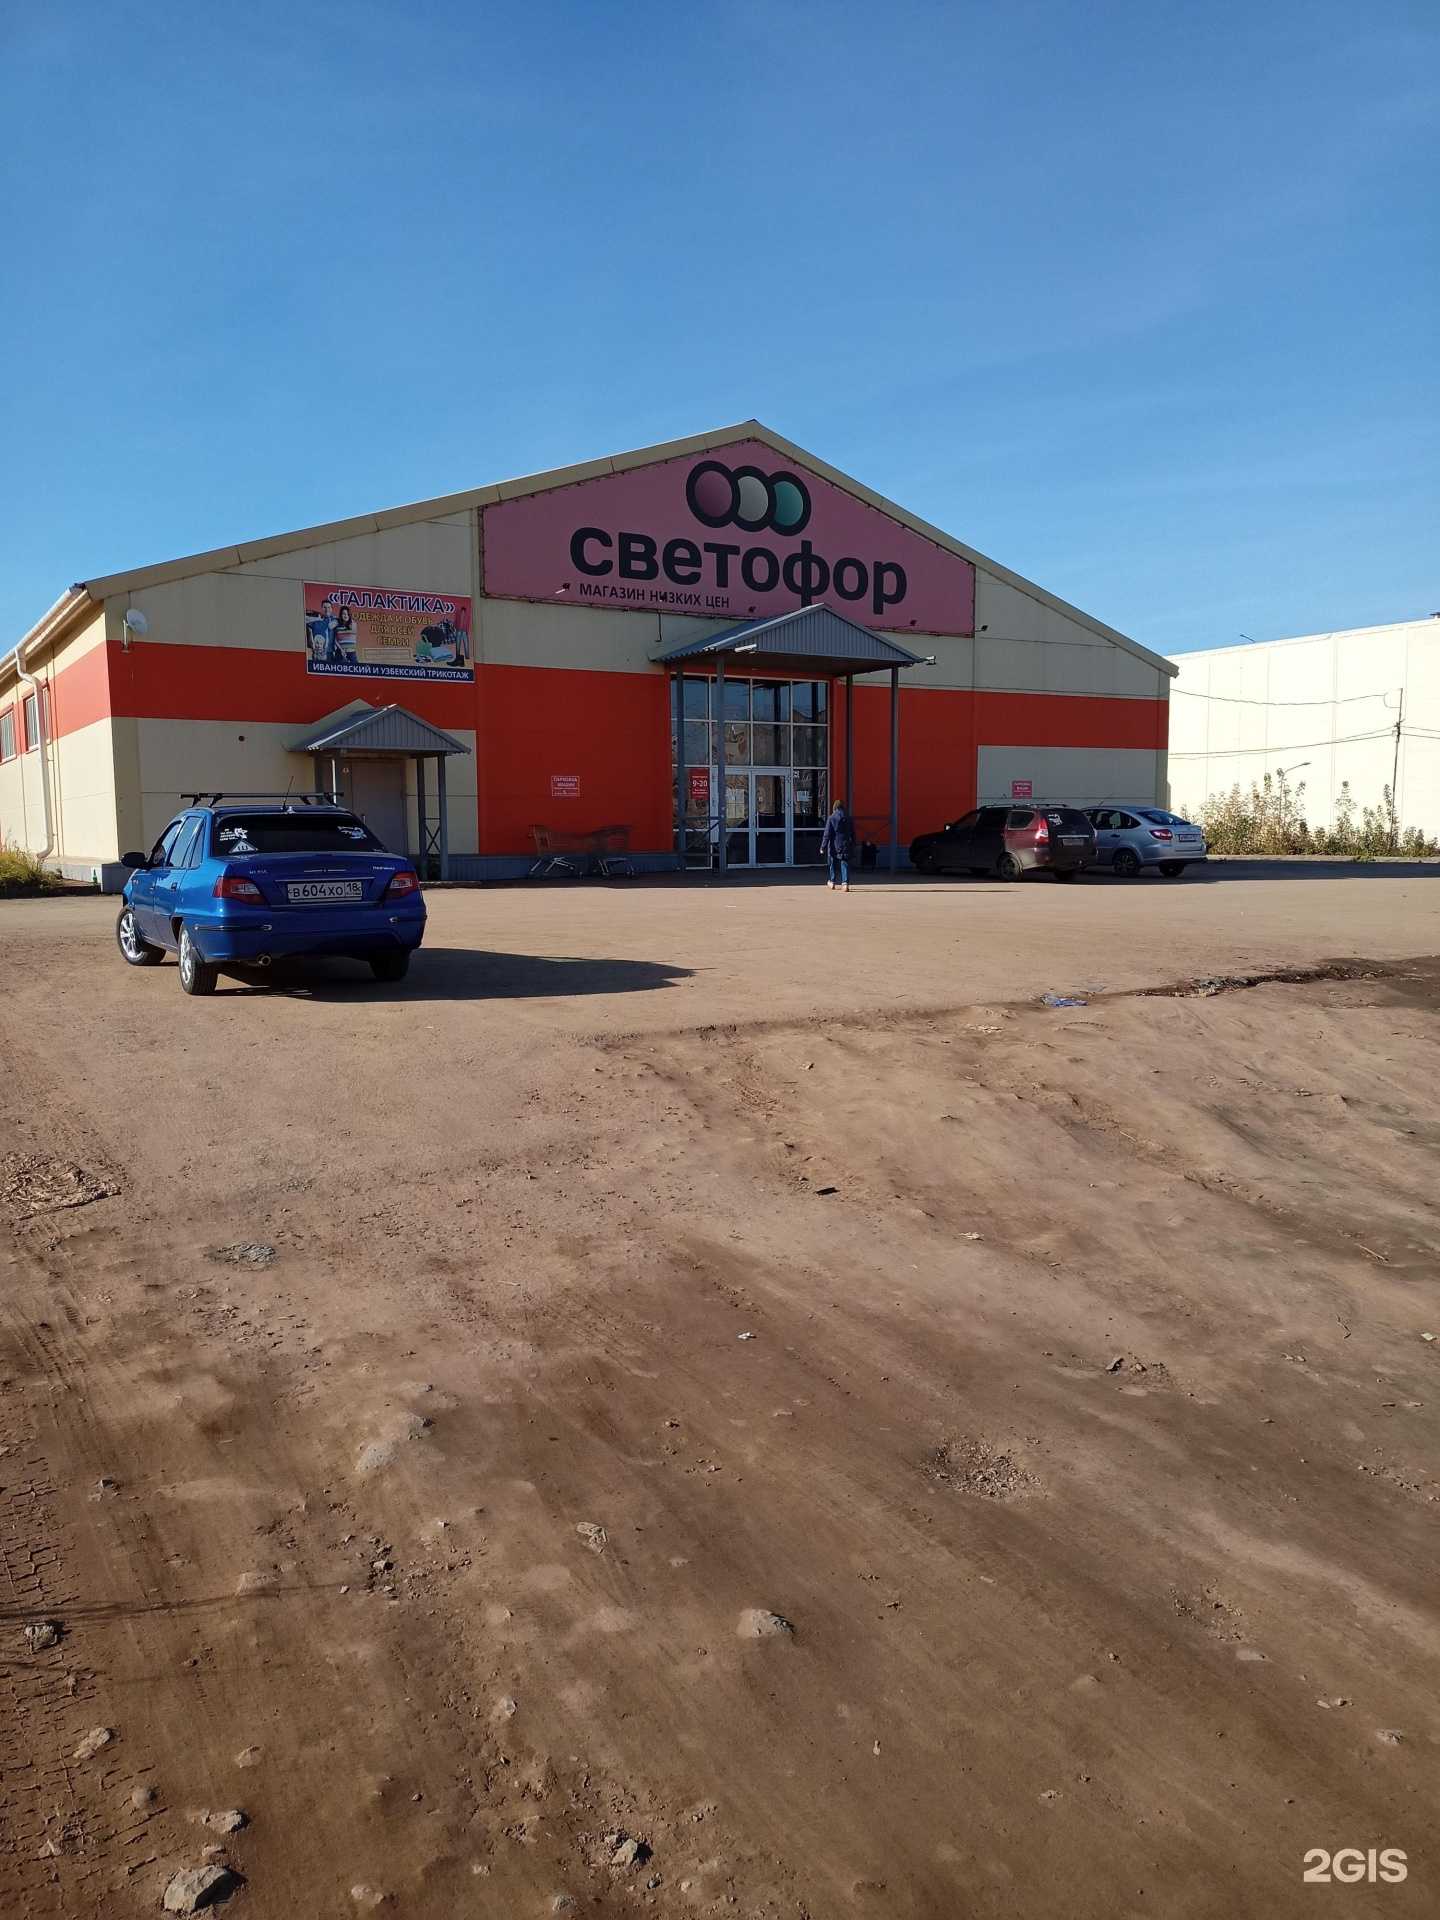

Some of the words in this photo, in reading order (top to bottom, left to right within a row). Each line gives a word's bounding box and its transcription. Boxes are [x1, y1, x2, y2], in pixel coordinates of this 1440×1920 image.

[327, 590, 456, 614] «ГАЛАКТИКА»
[579, 583, 645, 602] МАГАЗИН
[649, 589, 701, 606] НИЗКИХ
[705, 594, 730, 609] ЦЕН
[352, 612, 394, 622] ОДЕЖДА
[404, 616, 433, 625] ОБУВЬ
[370, 625, 389, 633] ДЛЯ
[391, 625, 415, 635] ВСЕЙ
[377, 636, 410, 646] СЕМЬИ
[312, 662, 372, 674] ИВАНОВСКИЙ
[373, 666, 380, 674] И
[381, 666, 426, 677] УЗБЕКСКИЙ
[427, 669, 469, 679] ТРИКОТАЖ
